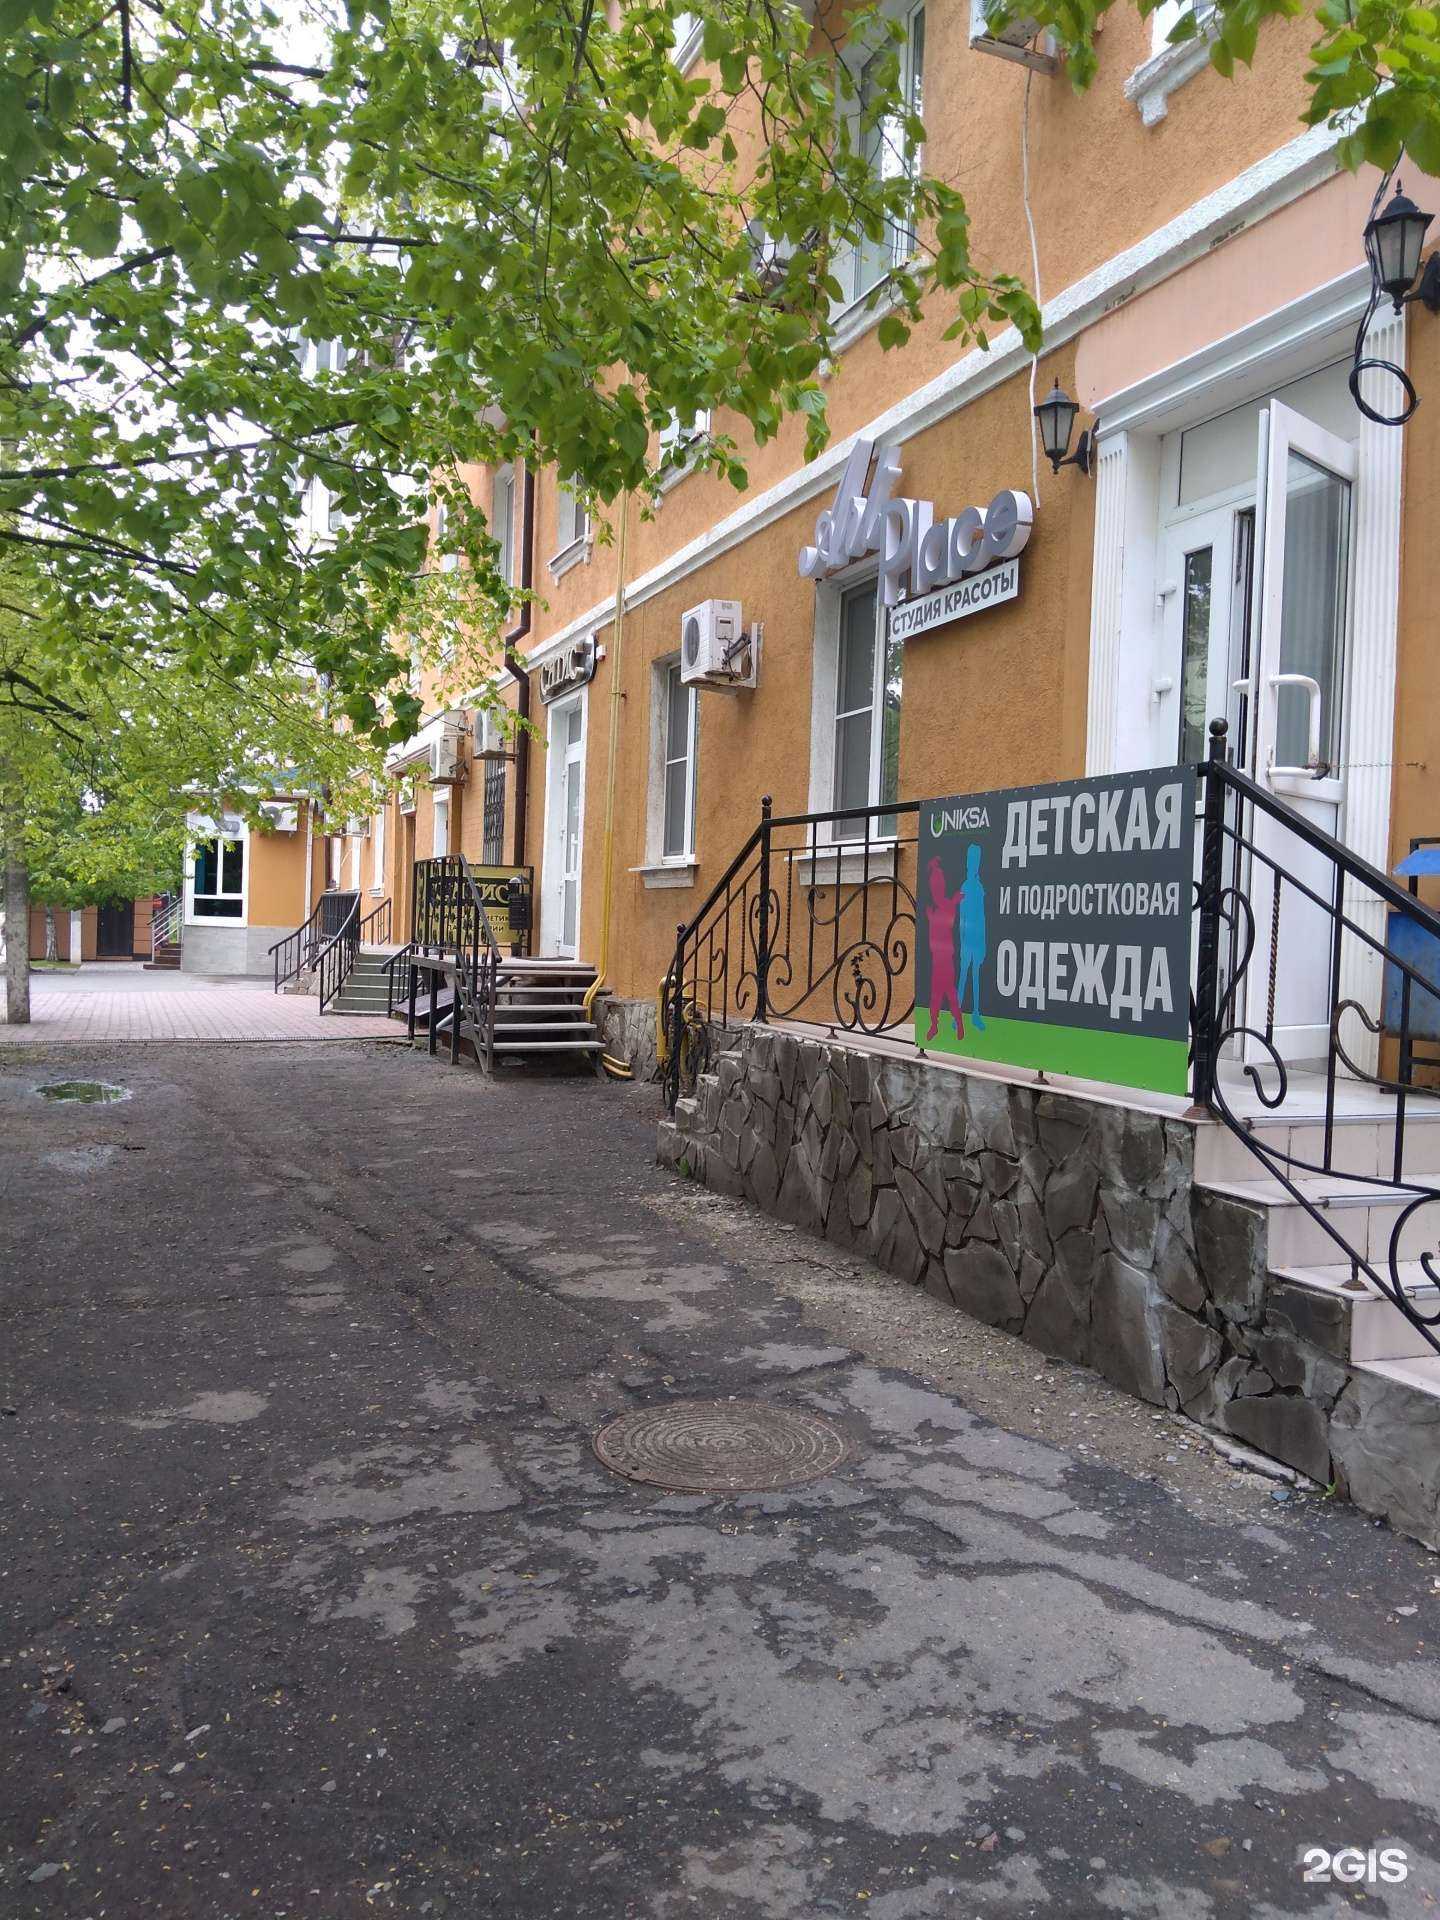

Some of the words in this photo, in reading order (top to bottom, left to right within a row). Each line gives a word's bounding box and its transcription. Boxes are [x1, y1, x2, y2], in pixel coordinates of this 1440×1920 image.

[891, 601, 942, 635] СТУДИЯ
[944, 568, 1015, 615] КРАСОТЫ
[930, 806, 990, 838] UNIKSA
[1001, 783, 1183, 869] ДЕТСКАЯ
[999, 886, 1011, 915] И
[1017, 882, 1180, 920] ПОДРОСТКОВАЯ
[996, 939, 1174, 1022] ОДЕЖДА
